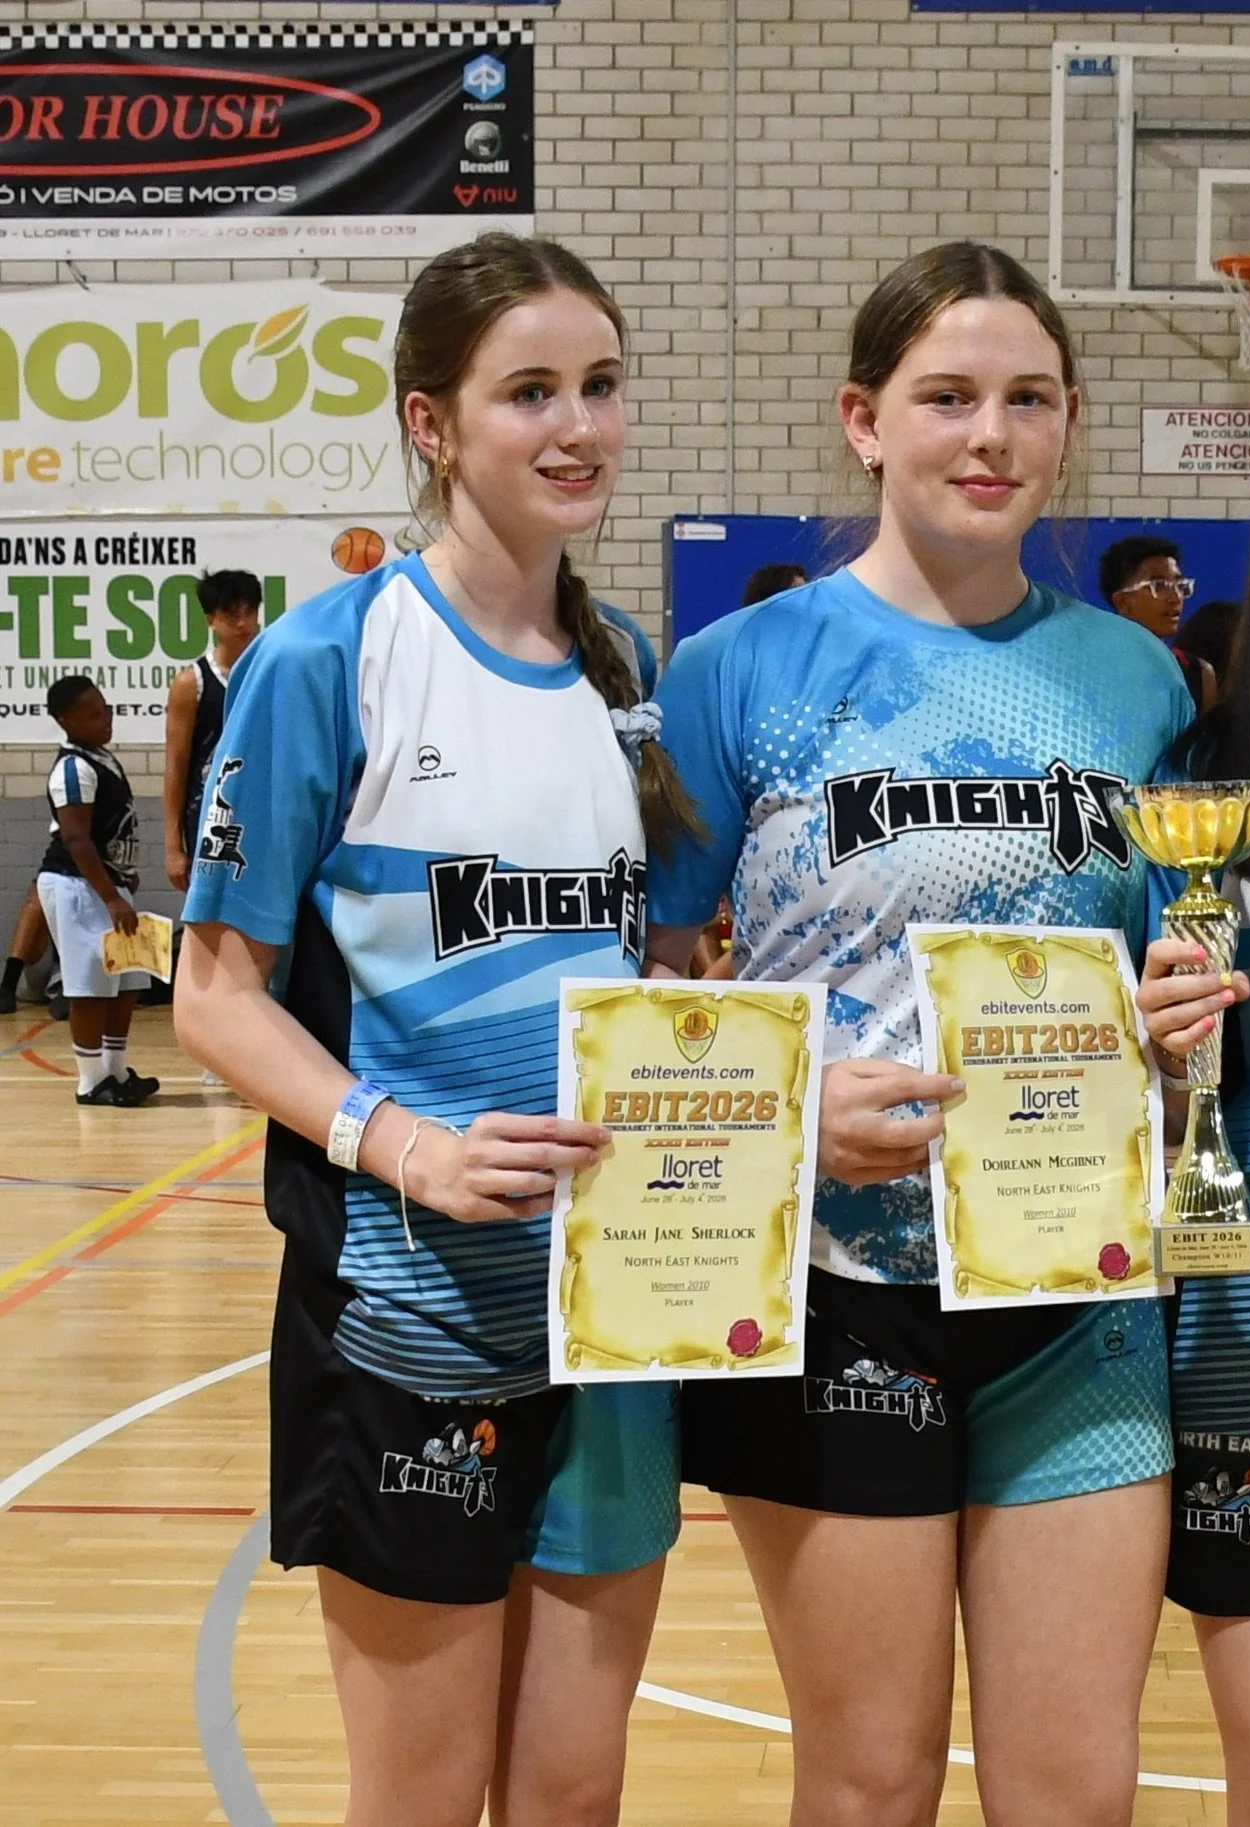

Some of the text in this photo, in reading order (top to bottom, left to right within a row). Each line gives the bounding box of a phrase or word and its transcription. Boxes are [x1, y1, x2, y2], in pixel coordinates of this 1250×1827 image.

[77, 92, 284, 142] HOUSE
[460, 160, 510, 173] Benelli
[31, 186, 137, 204] VENDA
[142, 186, 184, 203] DE
[189, 185, 298, 203] MOTOS
[23, 228, 91, 239] LLORET
[97, 228, 120, 238] DE
[381, 226, 417, 236] 039
[0, 316, 389, 423] oros
[1192, 429, 1209, 439] NO
[71, 427, 389, 493] technology
[1178, 460, 1194, 470] NO
[1197, 460, 1212, 471] US
[73, 537, 88, 565] A
[95, 532, 196, 566] CRÉIXER
[981, 1001, 1090, 1014] ebitevents.com
[961, 1023, 1120, 1057] EBIT2026
[631, 1065, 754, 1080] ebitevents.com
[1022, 1085, 1080, 1109] lloret
[602, 1091, 779, 1123] EBIT2026
[1047, 1111, 1080, 1120] de mar
[662, 1154, 723, 1178] lloret
[982, 1159, 1042, 1171] DOIREANN
[687, 1181, 722, 1190] de mar
[996, 1183, 1101, 1197] NORTH EAST KNIGHTS
[603, 1226, 756, 1243] SARAH JANE SHERLOCK
[1173, 1232, 1242, 1243] EBIT 2026
[624, 1256, 739, 1267] NORTH EAST KNIGHTS
[1180, 1431, 1221, 1451] RTH
[379, 1451, 498, 1518] KNIGHTS
